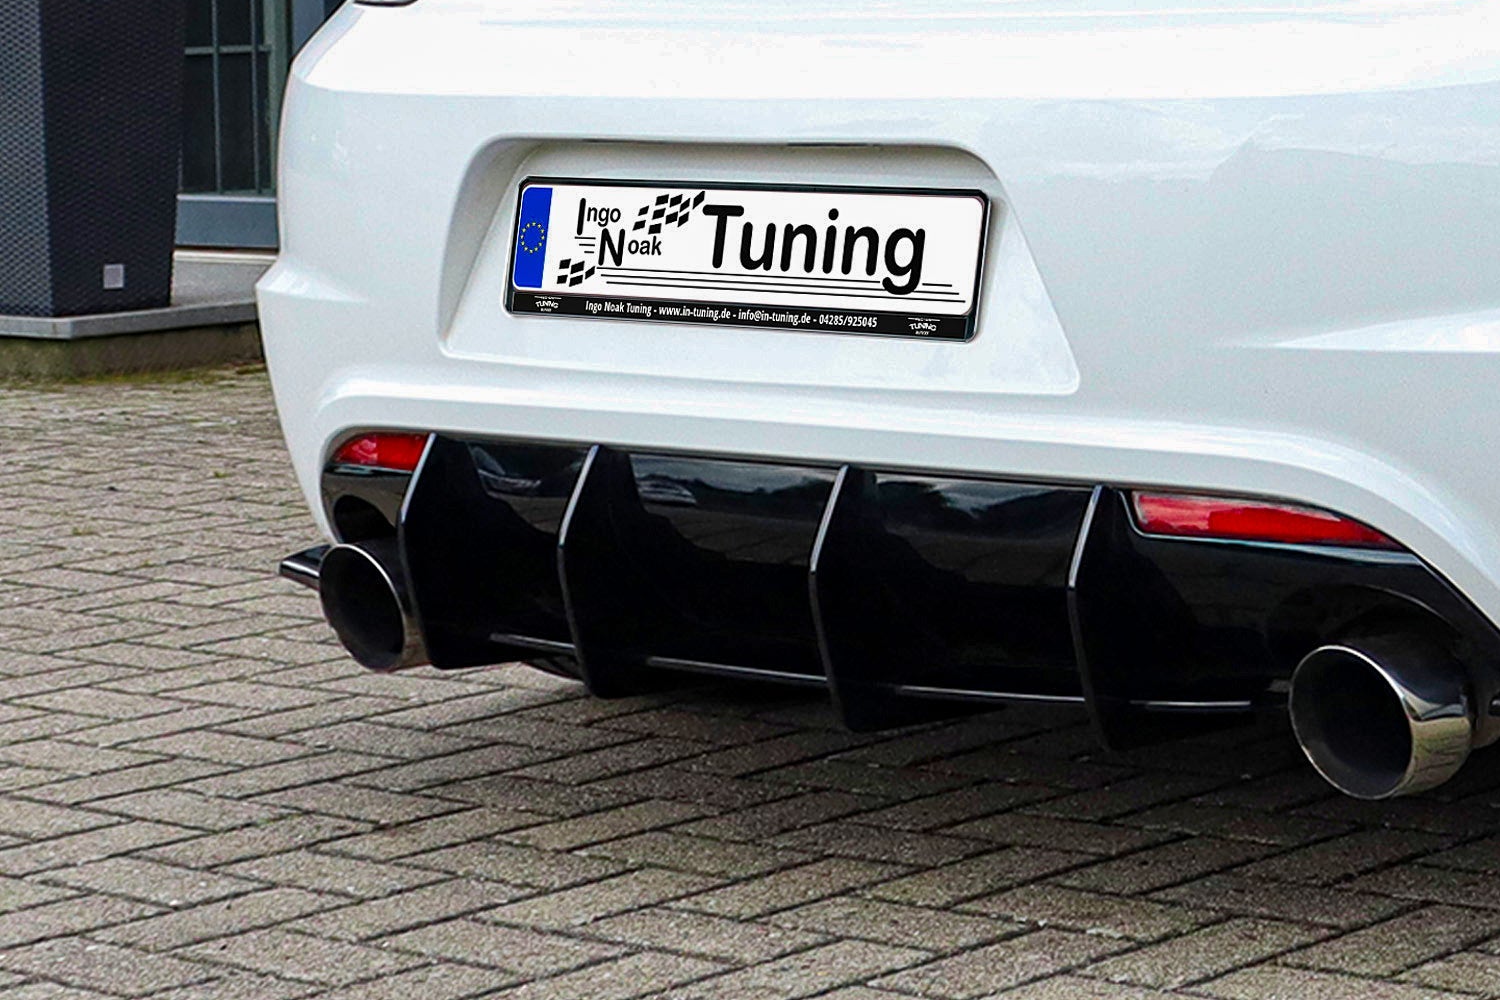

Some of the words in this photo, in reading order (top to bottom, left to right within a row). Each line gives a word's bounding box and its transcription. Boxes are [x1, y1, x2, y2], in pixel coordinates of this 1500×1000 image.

[577, 198, 621, 235] Ingo
[600, 227, 662, 267] Noak
[702, 204, 926, 294] Tuning
[585, 300, 602, 314] Ingo
[604, 301, 625, 313] Noak
[626, 302, 652, 317] Tuning
[658, 305, 731, 321] www.in-tuning.de
[738, 310, 811, 326] info@in-tuning.de
[818, 314, 878, 328] 04285/925045
